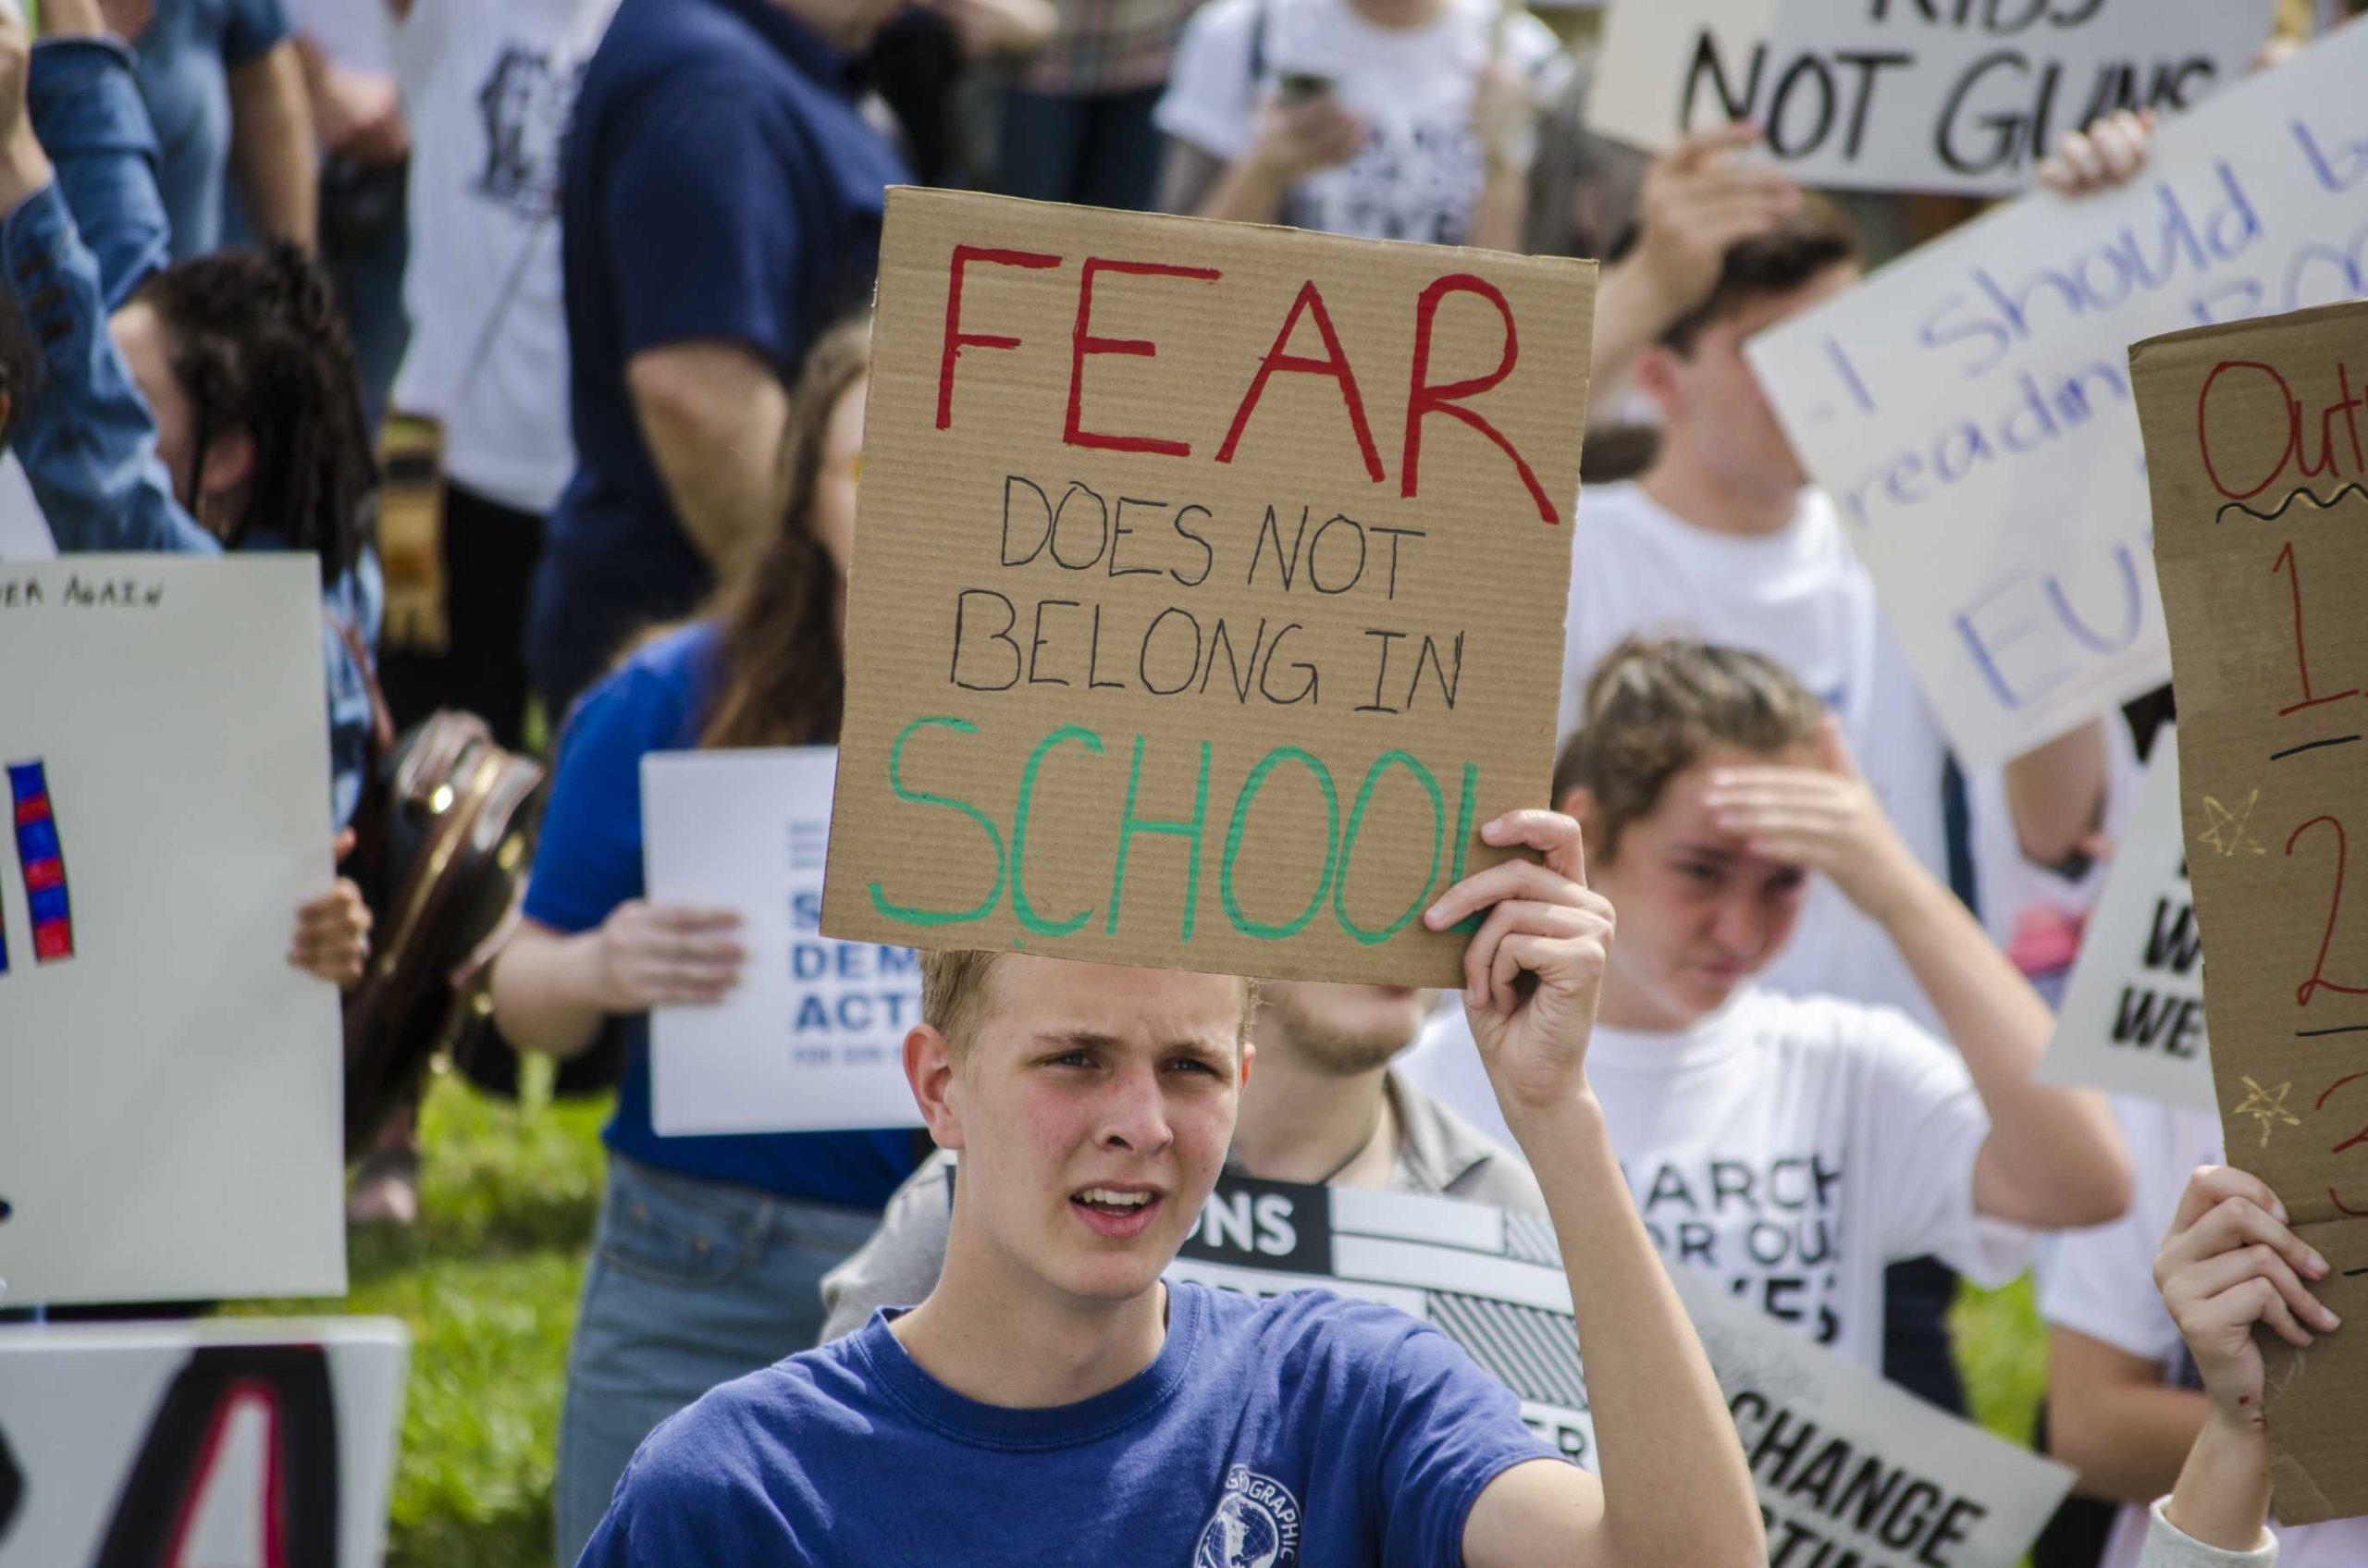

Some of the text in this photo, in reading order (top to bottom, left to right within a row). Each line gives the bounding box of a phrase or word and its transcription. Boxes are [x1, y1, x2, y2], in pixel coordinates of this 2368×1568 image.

[1680, 30, 1917, 161] NOT
[936, 245, 1560, 525] FEAR
[1002, 474, 1426, 600] DOES NOT
[950, 589, 1464, 714] BELONG IN
[868, 717, 1484, 945] SCHOOL
[1186, 1189, 1297, 1256] NS
[1621, 1152, 1841, 1214] ARCH
[1728, 1389, 1989, 1568] CHANGE
